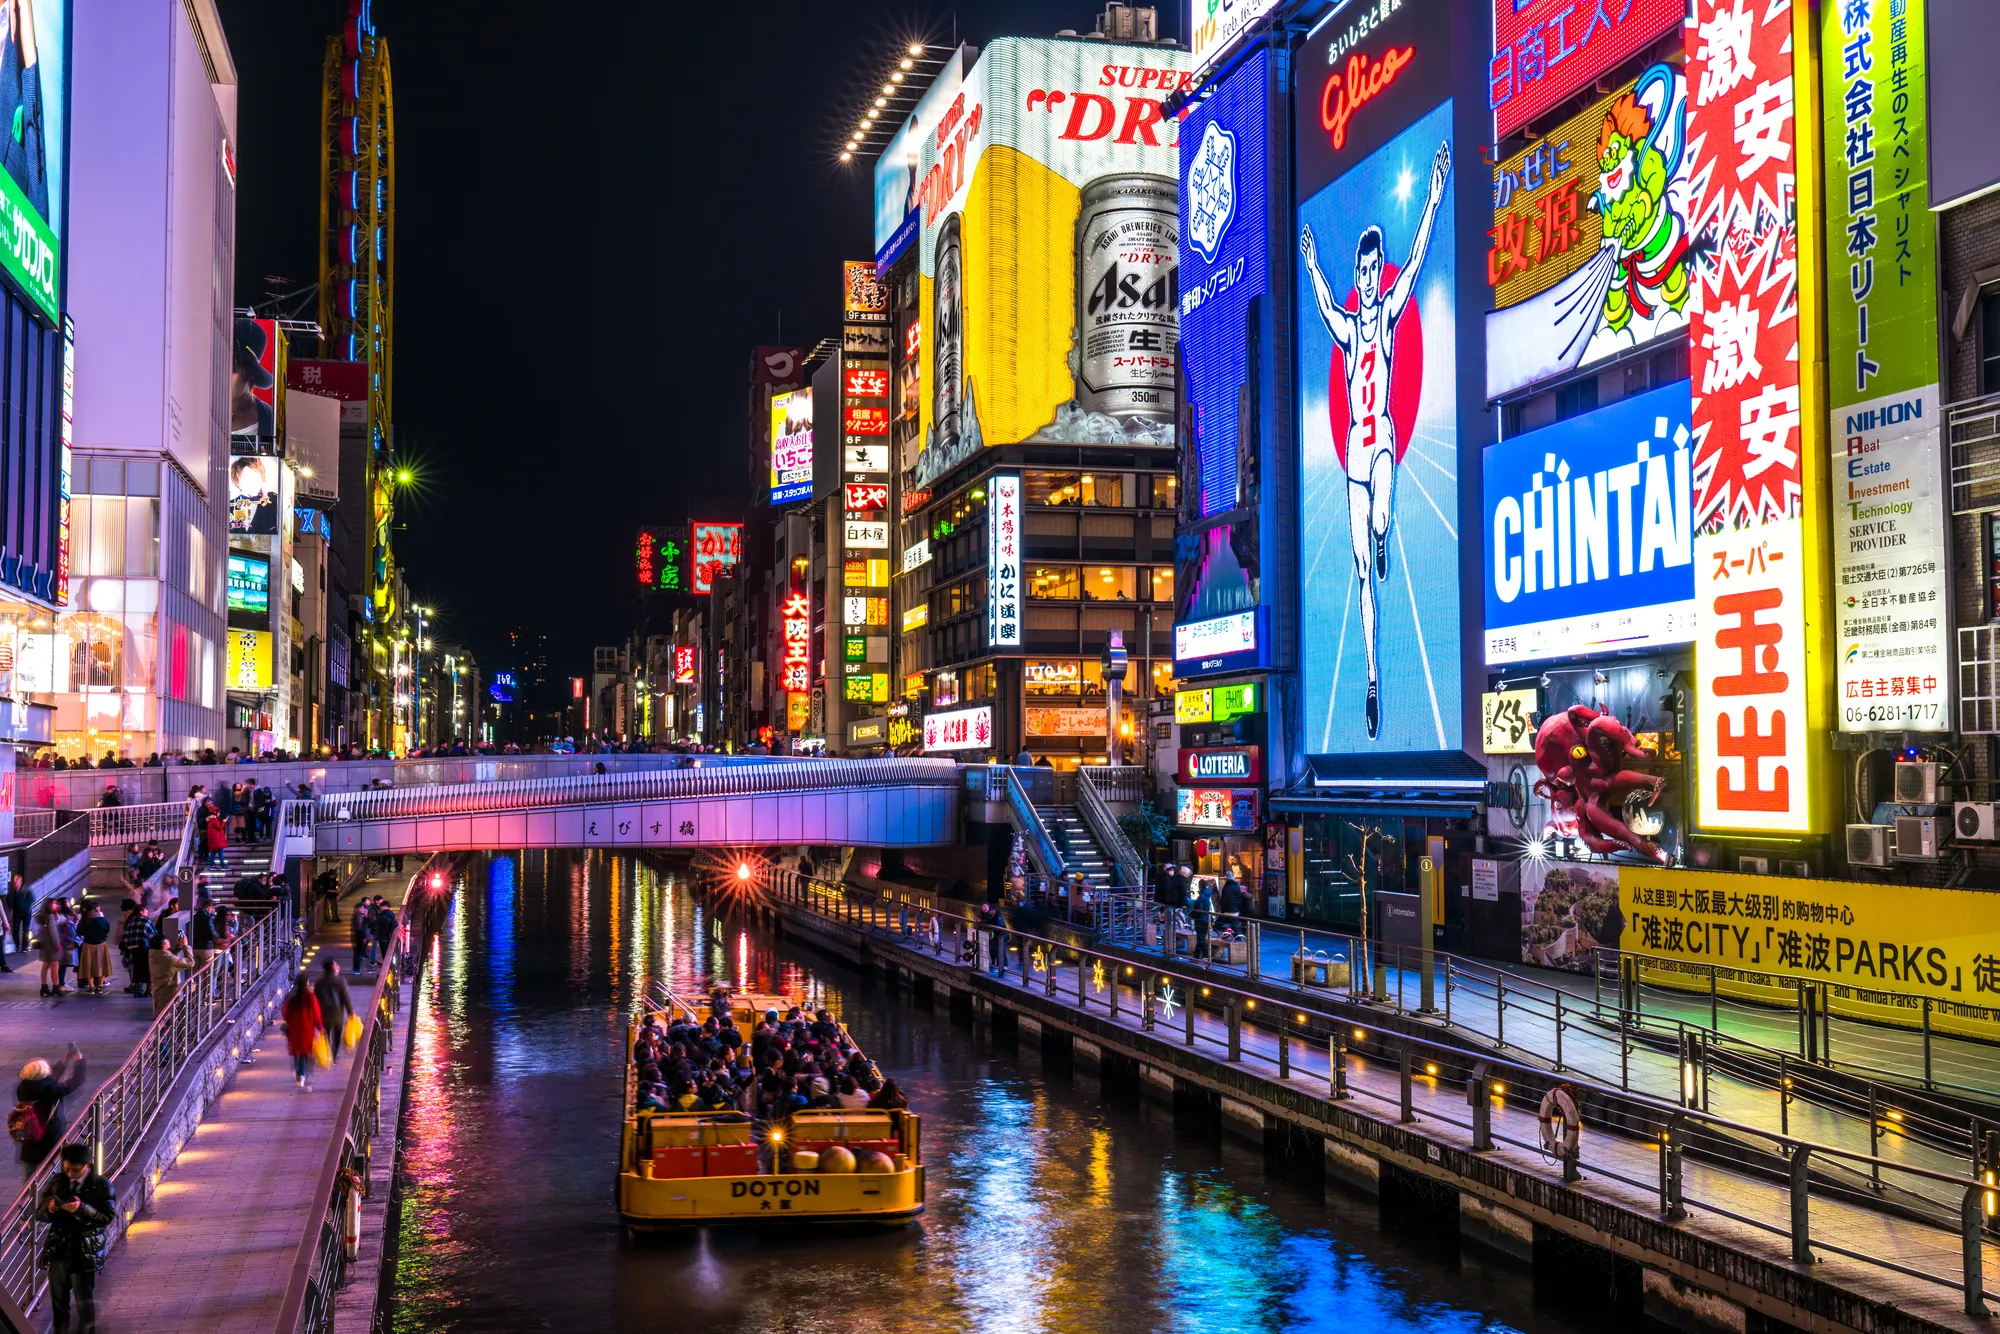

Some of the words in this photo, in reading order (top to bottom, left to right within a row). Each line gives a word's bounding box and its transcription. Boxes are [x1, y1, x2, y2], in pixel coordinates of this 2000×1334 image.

[1099, 64, 1194, 92] SUPER
[1322, 45, 1415, 150] Glico
[1495, 139, 1571, 208] かぜに
[1843, 0, 1879, 390] 株式会社日本リート
[1100, 229, 1119, 250] ASAHI
[1121, 221, 1162, 234] BREWERIES
[1487, 176, 1580, 287] 改源
[13, 204, 55, 303] サロンパス
[1182, 257, 1245, 316] 雪印メグミルク
[1129, 329, 1161, 352] 生
[1131, 391, 1160, 403] 350ml
[1360, 343, 1376, 447] グリコ
[1701, 294, 1799, 480] 激安
[846, 420, 888, 432] ダイニング
[1846, 398, 1922, 435] NIHON
[1847, 436, 1880, 457] Real
[1848, 457, 1891, 478] Estate
[1848, 478, 1910, 501] Investment
[1494, 417, 1692, 603] CHINTAI
[1847, 501, 1913, 521] Technology
[848, 525, 885, 541] 白木屋
[1001, 503, 1015, 557] 本場の味
[1849, 519, 1896, 538] SERVICE
[1850, 533, 1907, 553] PROVIDER
[1712, 540, 1784, 581] スーパー
[1861, 590, 1937, 609] 全日本不動産協会
[1846, 675, 1937, 698] 広告主募集中
[1712, 587, 1790, 813] 玉出
[1846, 704, 1938, 722] 06-6281-1717
[1200, 755, 1245, 774] LOTTERIA
[588, 821, 695, 836] えびす橋
[1394, 907, 1416, 917] information
[732, 1179, 821, 1198] DOTON
